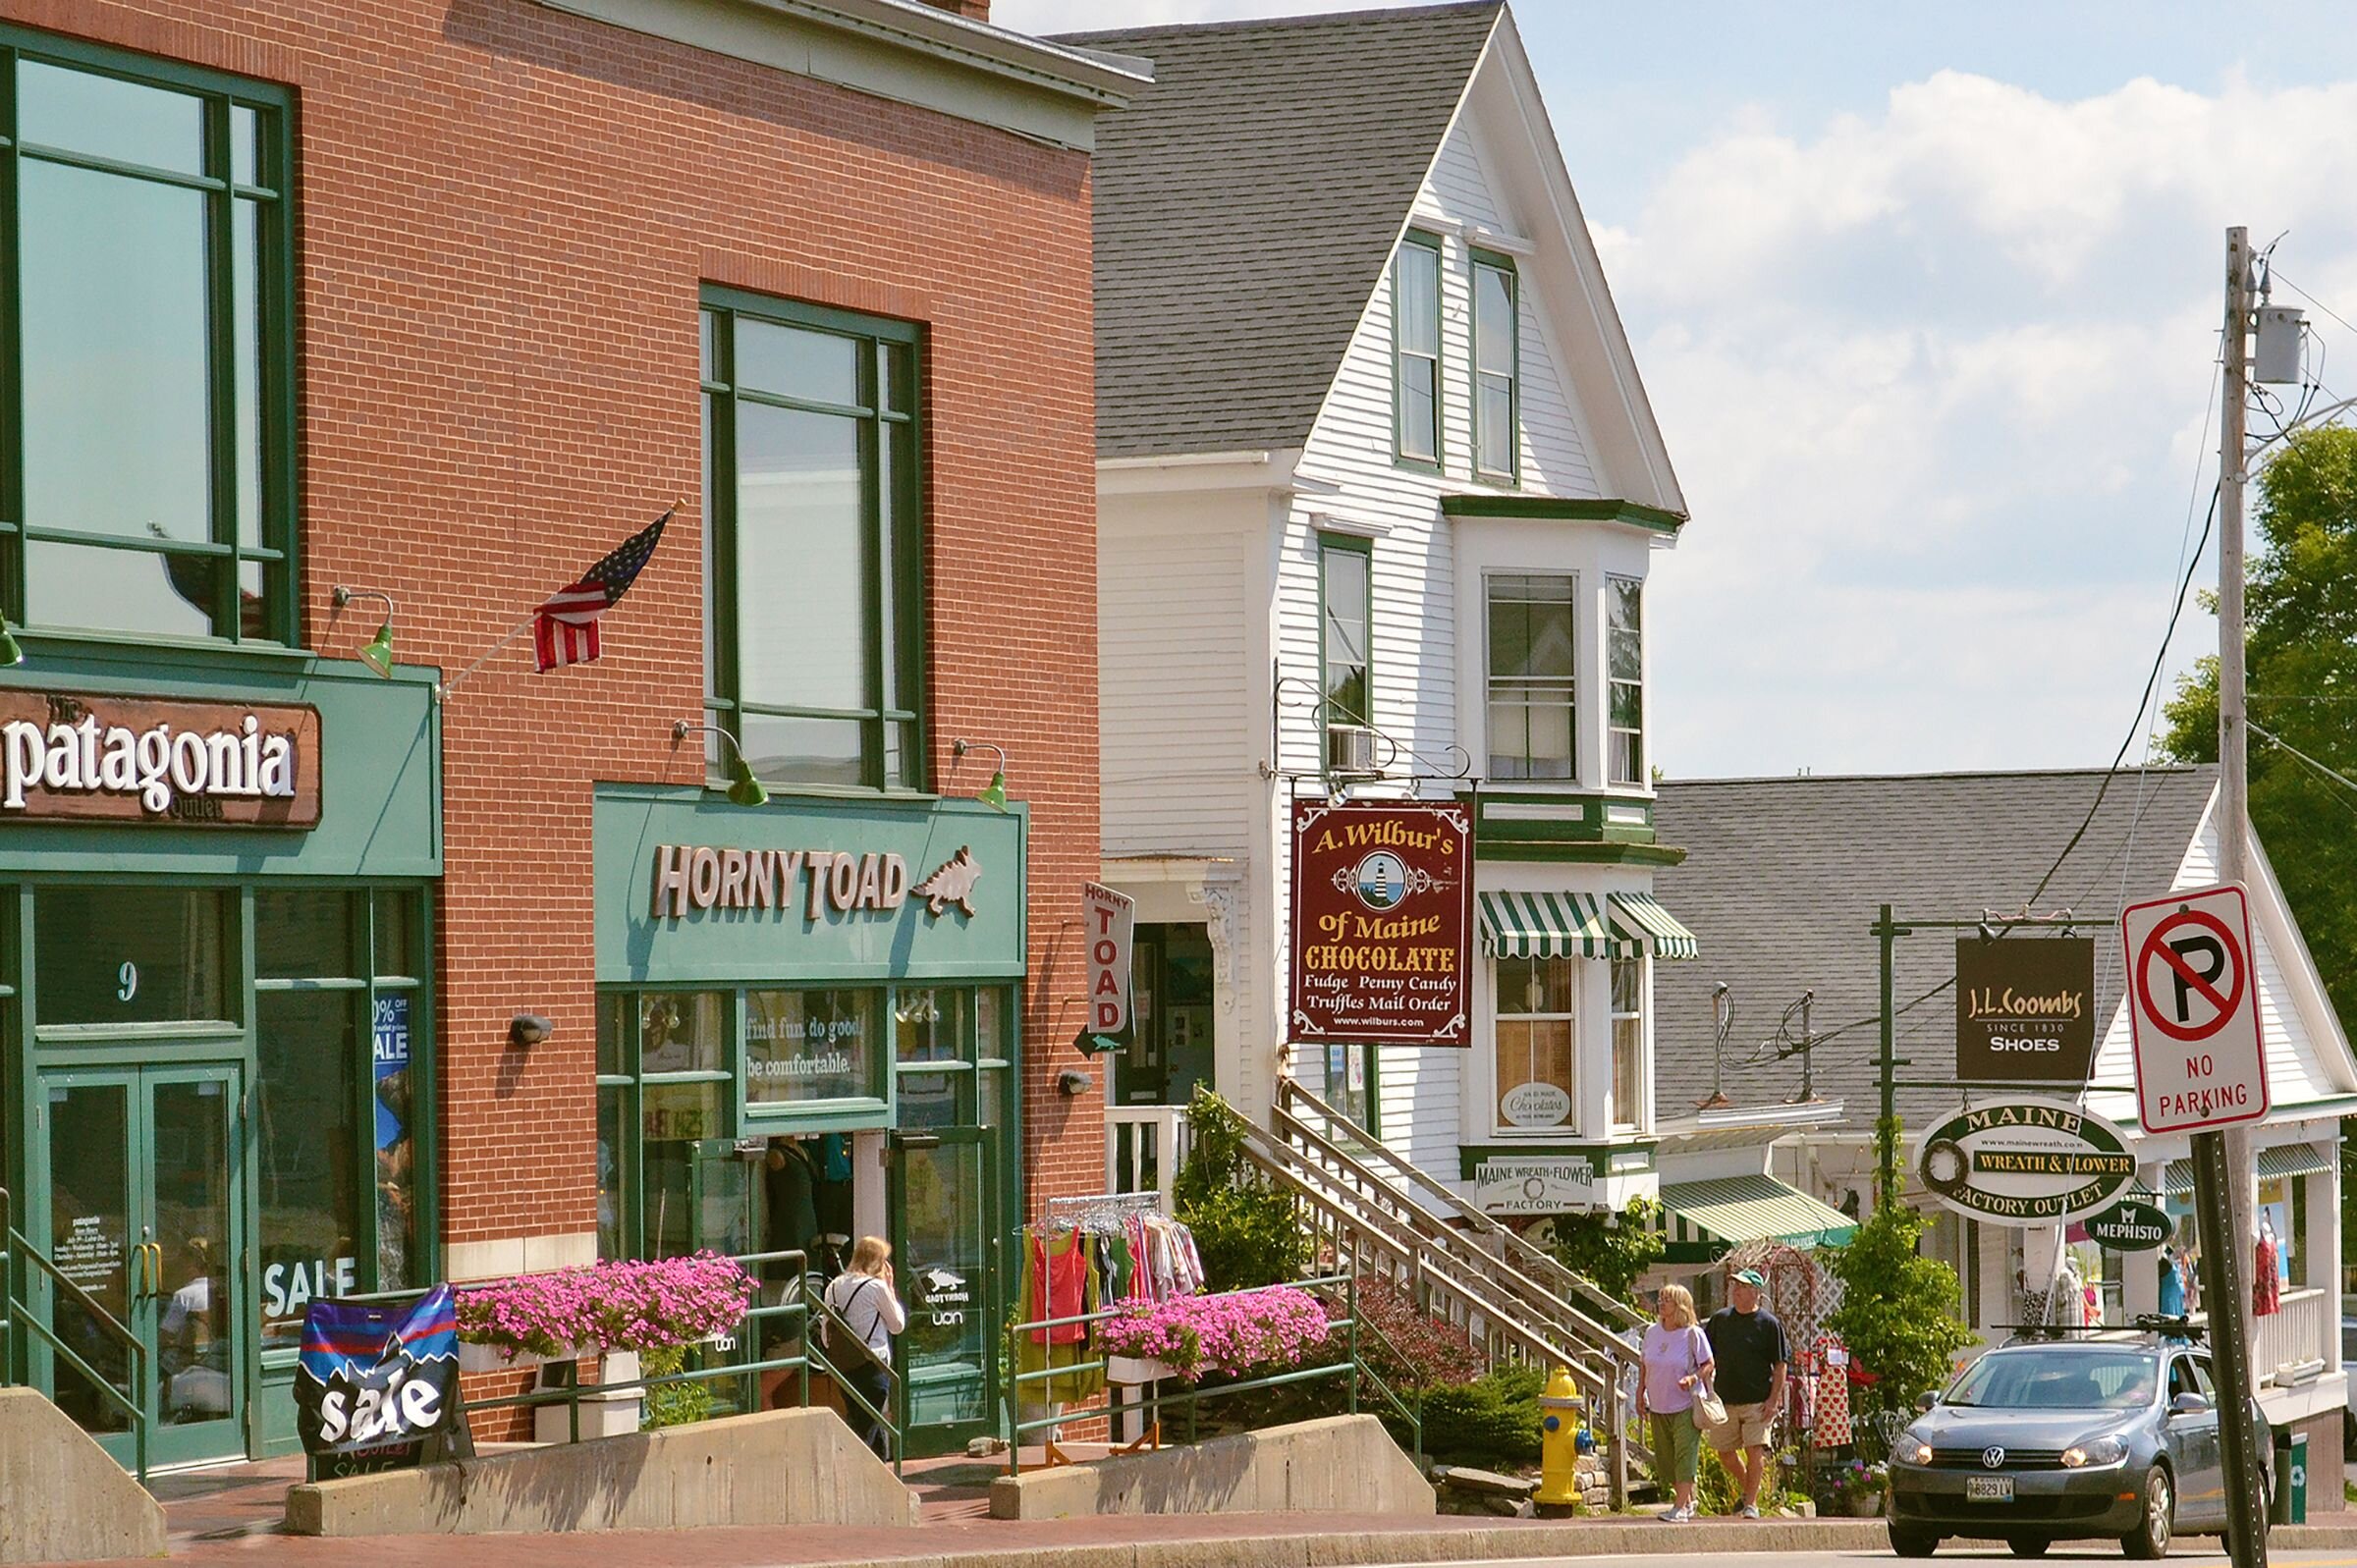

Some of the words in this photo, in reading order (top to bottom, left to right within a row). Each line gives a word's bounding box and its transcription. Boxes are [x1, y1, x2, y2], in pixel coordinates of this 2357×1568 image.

[3, 714, 295, 812] patagonia
[1344, 820, 1453, 854] Wilbur's
[652, 844, 802, 918] HORNY
[802, 850, 908, 920] TOAD
[1085, 885, 1128, 910] HORNY
[1319, 910, 1352, 943] of
[1353, 914, 1441, 940] Maine
[1094, 906, 1120, 1028] TOAD
[1305, 946, 1454, 972] CHOCOLATE
[118, 961, 137, 1001] 9
[1304, 973, 1349, 994] Fudge
[1359, 975, 1404, 995] Penny
[1408, 975, 1456, 997] Candy
[395, 999, 408, 1008] OFF
[1307, 994, 1364, 1014] Truffles
[1368, 995, 1405, 1010] Mail
[1408, 996, 1452, 1011] Order
[746, 1017, 776, 1040] find
[809, 1016, 825, 1038] do
[1334, 1016, 1424, 1027] www.wilburs.com
[1987, 1023, 2025, 1033] SINCE
[2035, 1023, 2063, 1033] 1830
[374, 1033, 408, 1059] ALE
[1990, 1036, 2060, 1052] SHOES
[746, 1055, 762, 1077] be
[766, 1053, 850, 1076] comfortable.
[2186, 1054, 2213, 1079] NO
[2161, 1083, 2247, 1116] PARKING
[1966, 1107, 2081, 1133] MAINE
[1981, 1154, 2045, 1171] WREATH
[2049, 1154, 2062, 1172] &
[1478, 1166, 1512, 1189] MAINE
[1514, 1166, 1549, 1178] WREATH
[1554, 1165, 1593, 1188] FLOWER
[1507, 1200, 1562, 1210] FACTORY
[1953, 1185, 2028, 1215] FACTORY
[2097, 1222, 2162, 1241] MEPHISTO
[319, 1367, 441, 1442] sale
